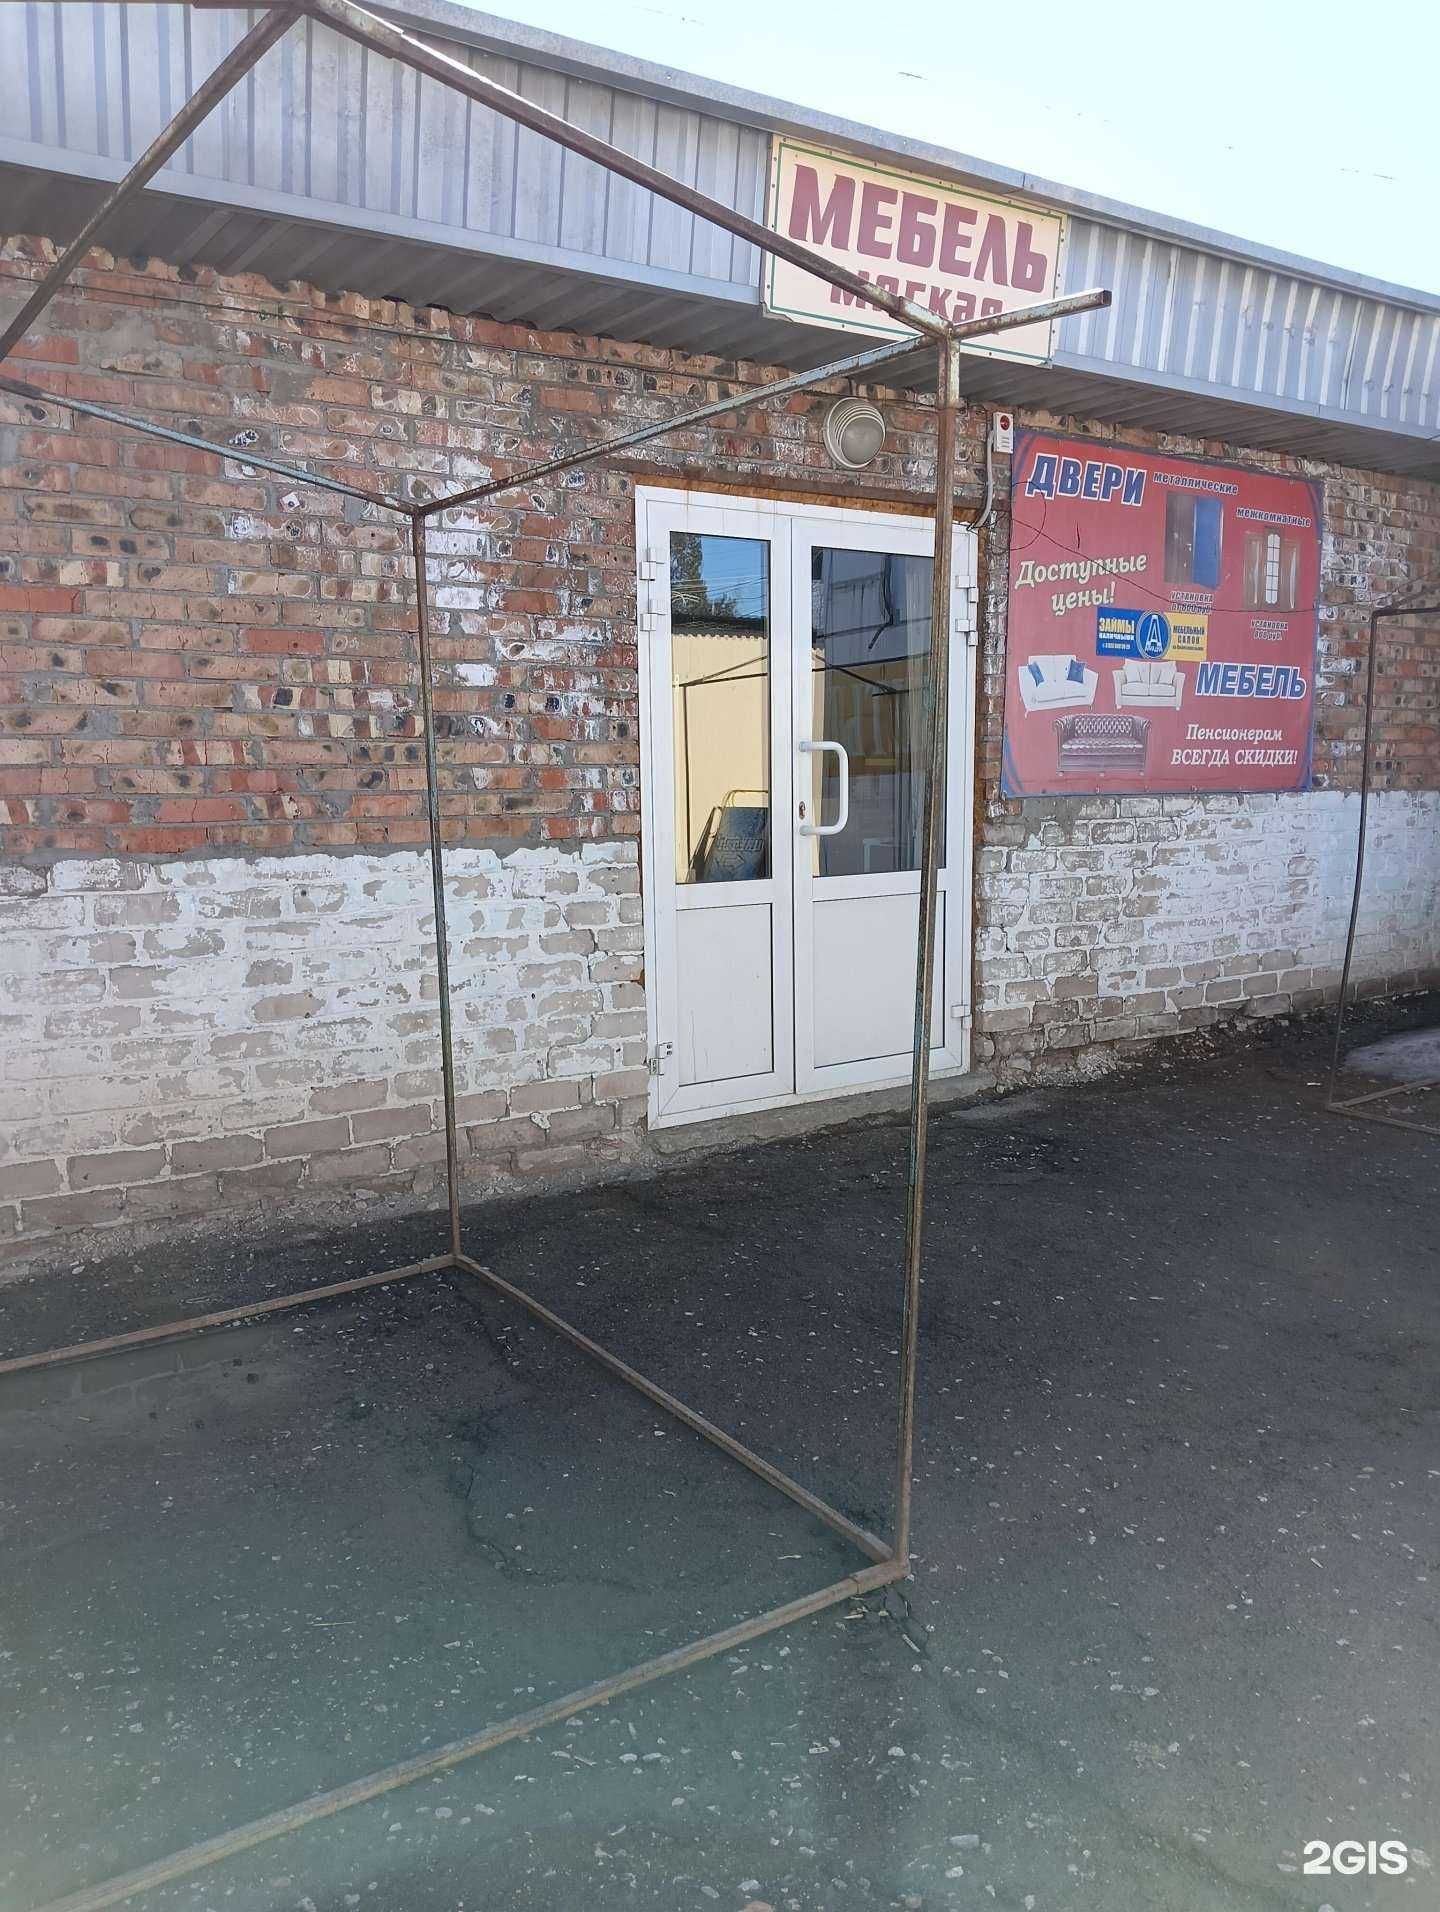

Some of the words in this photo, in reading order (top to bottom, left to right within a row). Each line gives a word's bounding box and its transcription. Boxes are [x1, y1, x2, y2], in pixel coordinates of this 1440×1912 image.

[788, 163, 1048, 293] МЕБЕЛЬ
[1025, 453, 1147, 507] ДВЕРИ
[1153, 471, 1239, 495] металлические
[1236, 507, 1312, 527] межкомнатные
[1015, 552, 1148, 589] Доступные
[1051, 582, 1116, 616] цены!
[1099, 617, 1135, 635] ЗАЙМЫ
[1195, 661, 1307, 700] МЕБЕЛЬ
[1186, 724, 1282, 744] Пенсионерам
[1170, 749, 1230, 767] ВСЕГДА
[1235, 750, 1298, 767] СКИДКИ!
